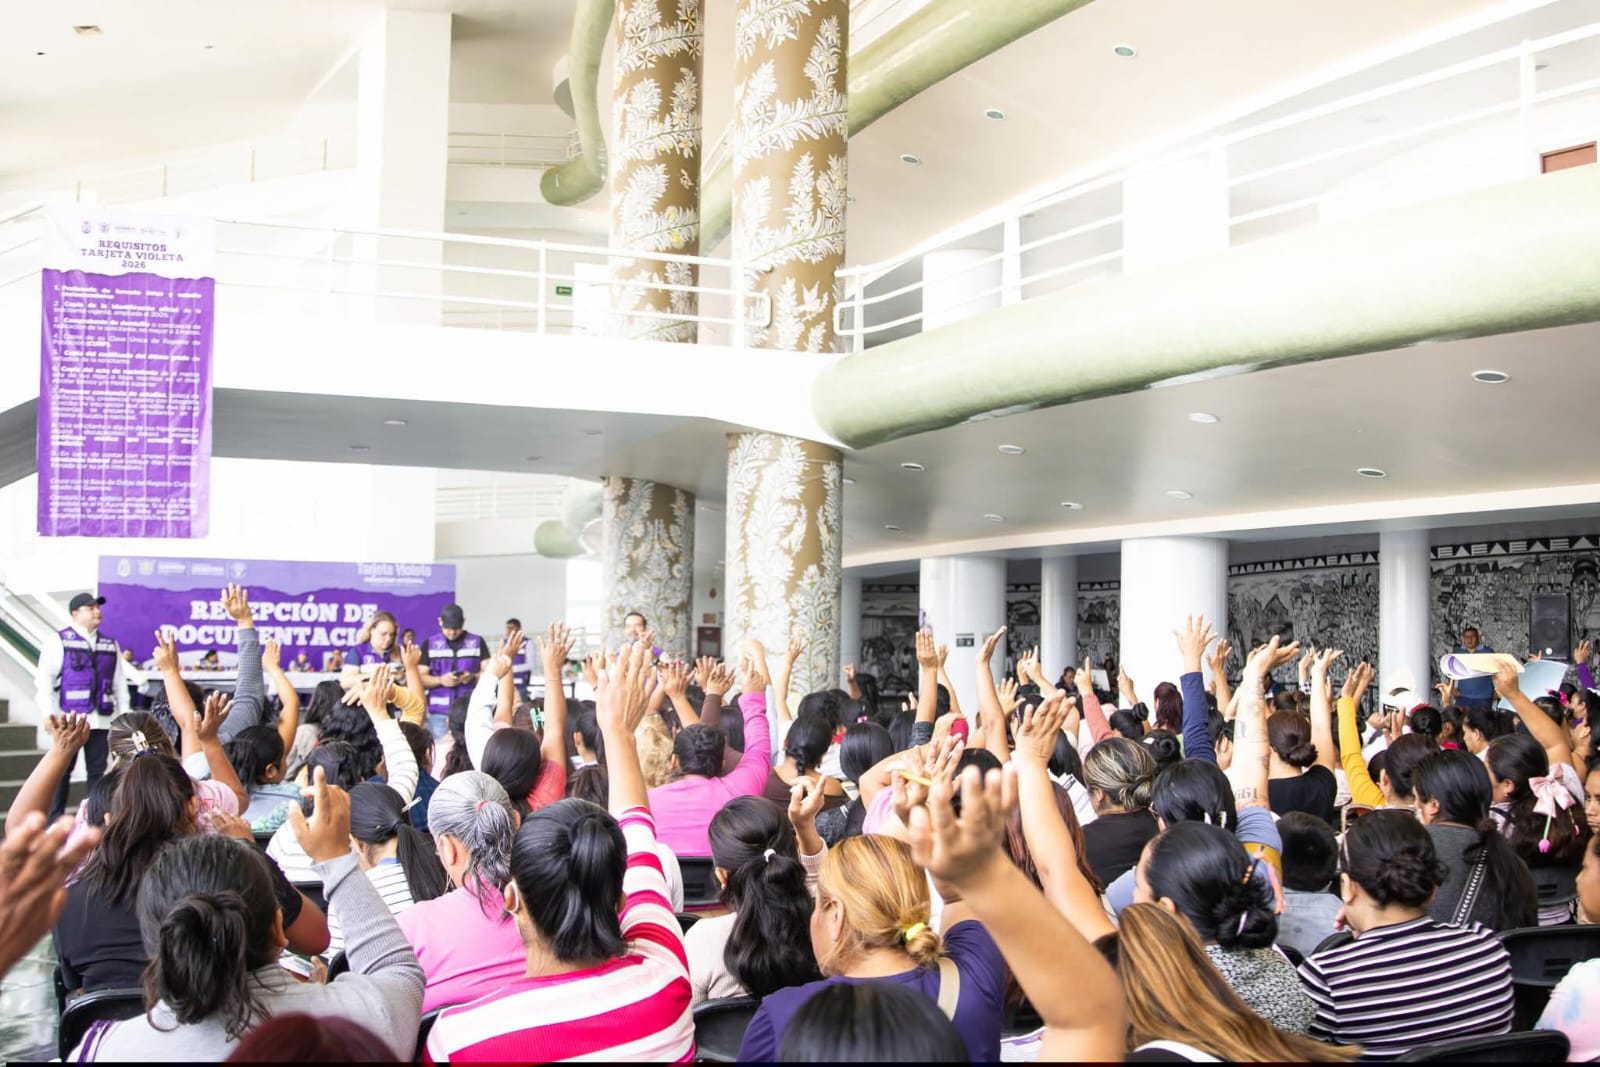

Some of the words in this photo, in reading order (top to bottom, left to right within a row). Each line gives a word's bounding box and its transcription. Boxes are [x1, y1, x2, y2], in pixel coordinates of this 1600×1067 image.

[98, 240, 168, 252] REQUISITOS
[80, 248, 132, 259] TARJETA
[135, 251, 184, 262] VIOLETA
[121, 260, 147, 269] 2026
[190, 594, 339, 623] REEPCIÓN
[343, 603, 378, 623] DE
